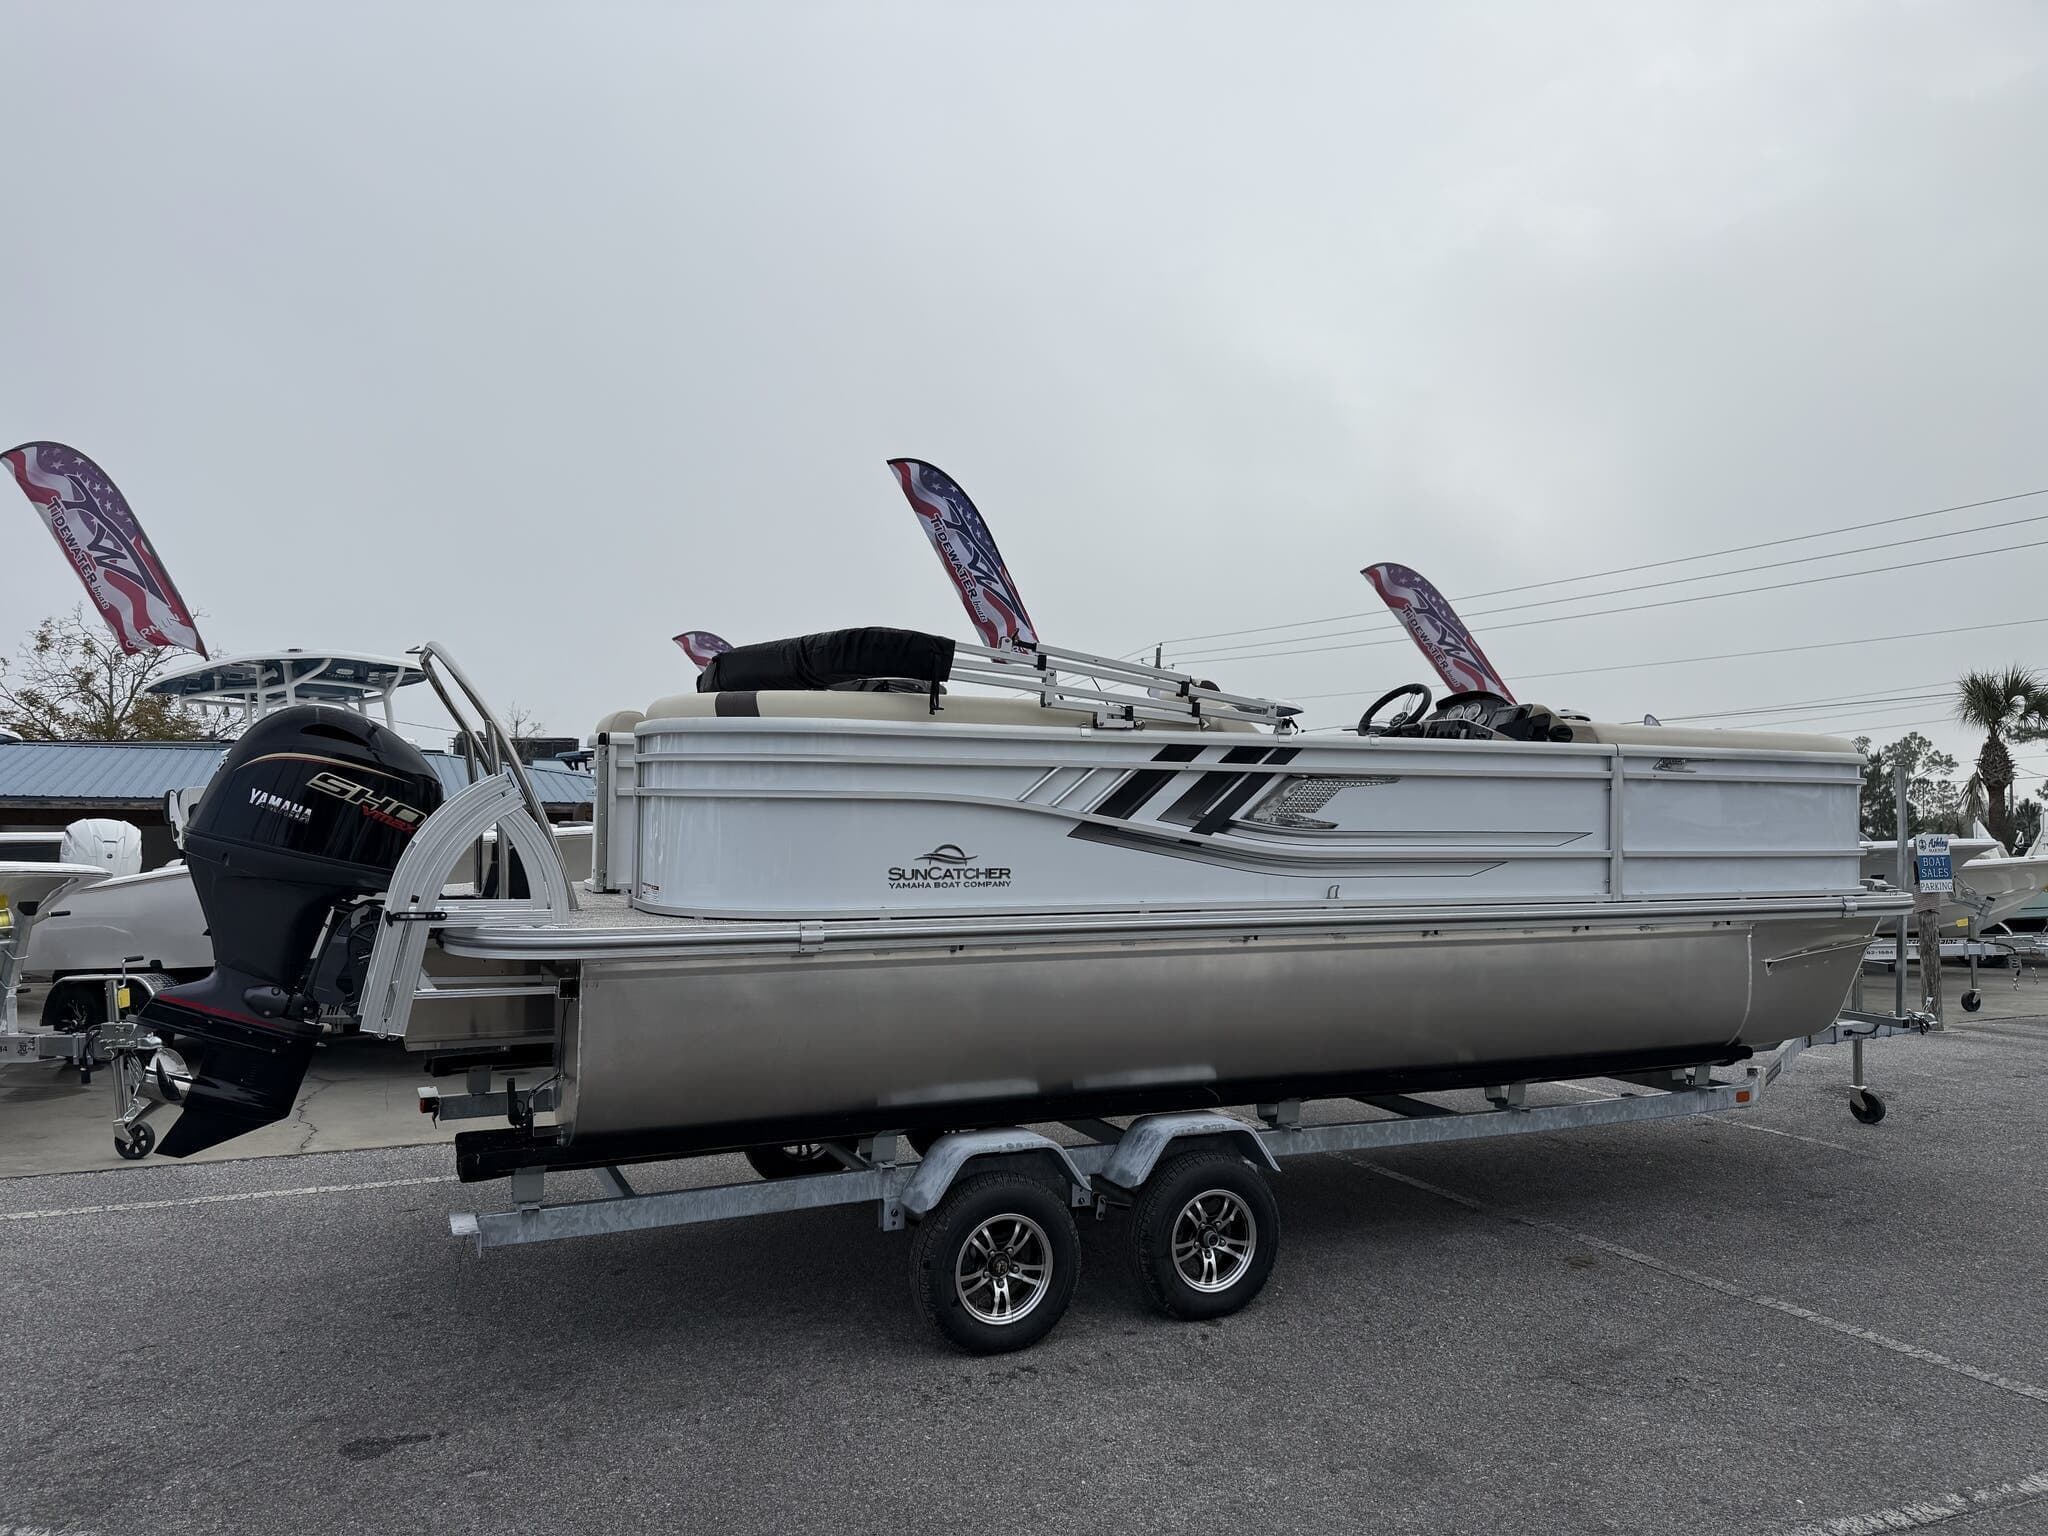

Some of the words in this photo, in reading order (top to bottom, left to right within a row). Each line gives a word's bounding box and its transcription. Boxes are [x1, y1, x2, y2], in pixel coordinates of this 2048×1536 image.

[46, 496, 99, 588] TIDEWATER
[93, 585, 110, 609] boats
[931, 513, 977, 597] TIDEWATER
[973, 598, 988, 623] boats
[1402, 604, 1448, 669] TIDEWATER
[249, 788, 312, 823] YAMAHA
[305, 771, 428, 828] SHO
[1928, 837, 1949, 852] Ashley
[1921, 867, 1949, 878] SALES
[1923, 857, 1946, 867] BOAT
[888, 881, 932, 889] YAMAHA
[934, 881, 961, 889] BOAT
[1920, 881, 1953, 891] PARKING
